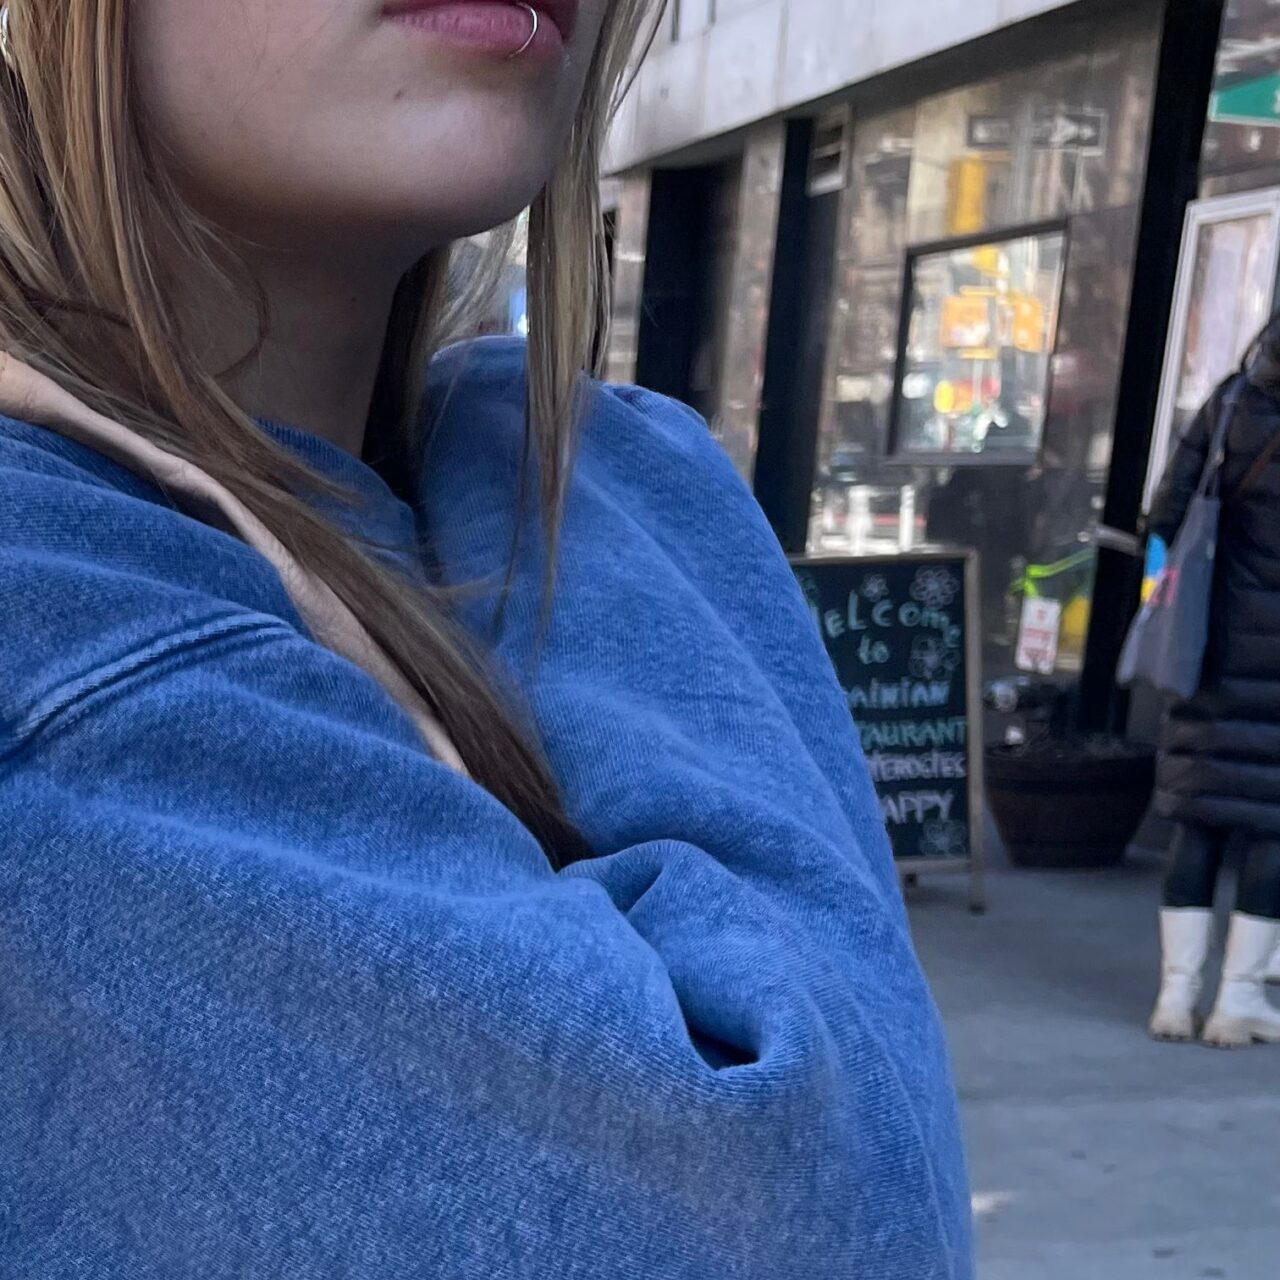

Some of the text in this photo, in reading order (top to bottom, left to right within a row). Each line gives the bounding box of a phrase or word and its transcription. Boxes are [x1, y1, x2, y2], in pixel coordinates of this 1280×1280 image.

[818, 590, 961, 648] ELCOme
[857, 716, 967, 749] TAURANT
[880, 790, 954, 823] APPY
